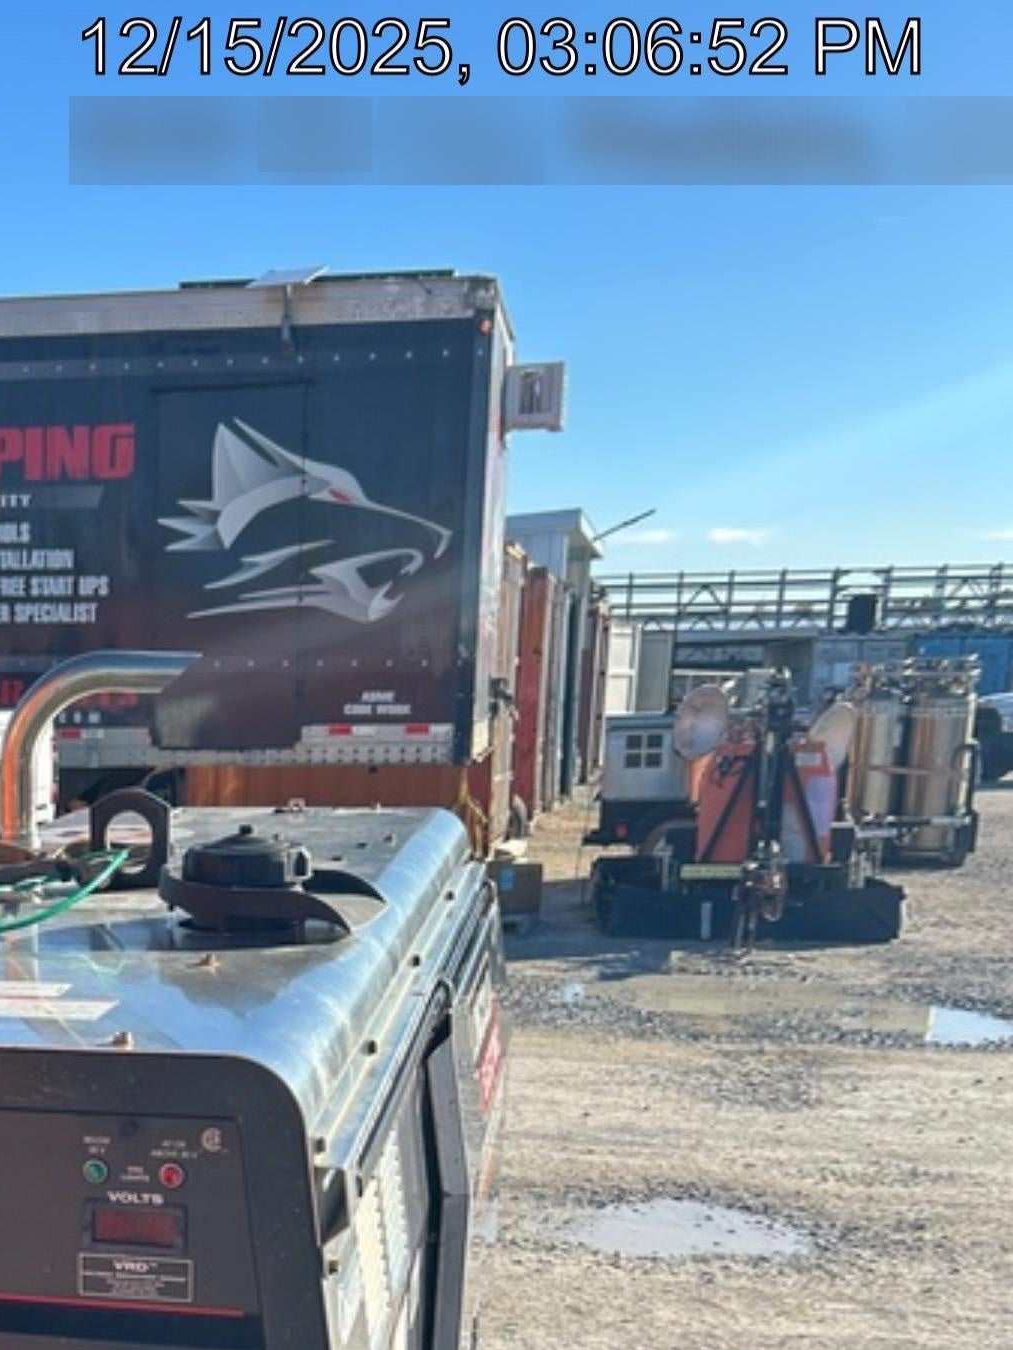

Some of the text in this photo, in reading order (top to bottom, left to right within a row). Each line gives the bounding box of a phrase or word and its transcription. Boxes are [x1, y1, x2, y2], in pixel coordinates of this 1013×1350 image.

[30, 575, 75, 596] START
[78, 574, 110, 596] UPS
[13, 602, 99, 623] SPECIALIST
[107, 1190, 164, 1204] VOLTS
